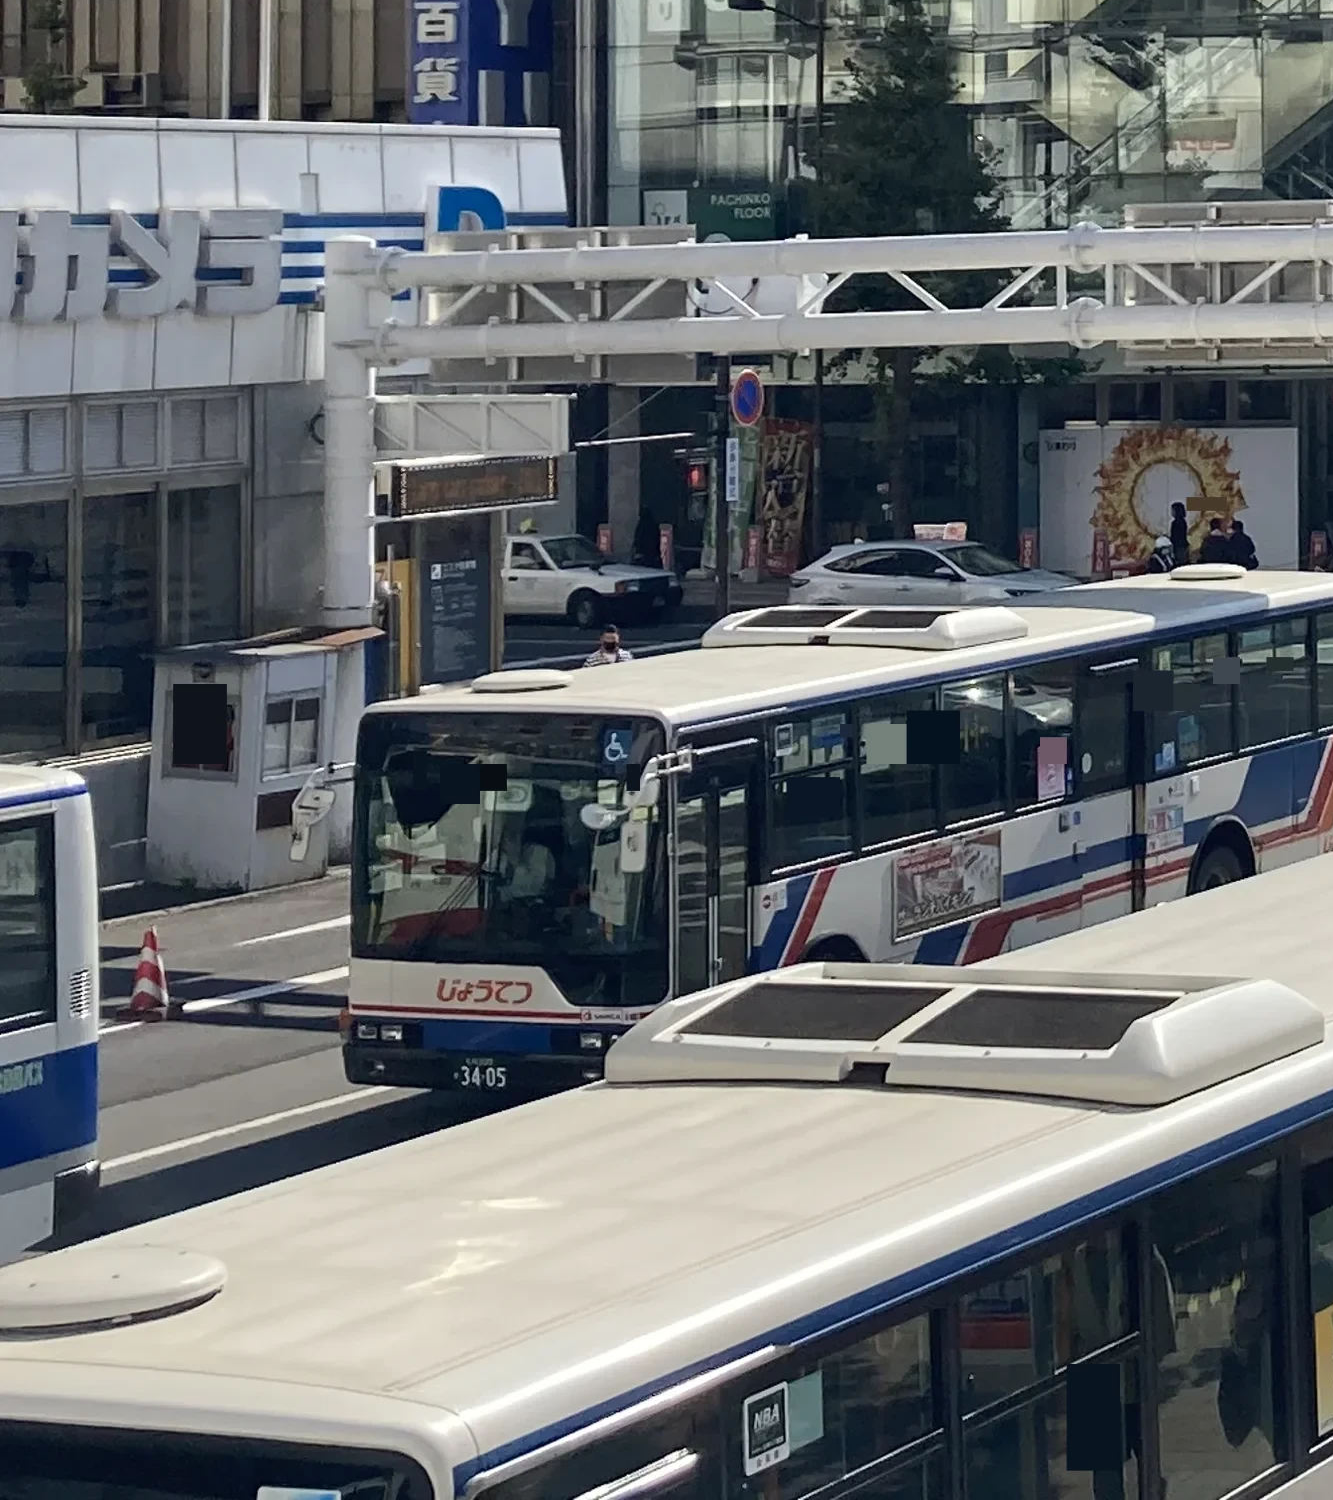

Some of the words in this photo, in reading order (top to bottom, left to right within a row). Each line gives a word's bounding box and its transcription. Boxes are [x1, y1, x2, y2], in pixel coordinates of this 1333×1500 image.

[709, 192, 771, 206] PACHINKO
[436, 977, 533, 1005] じょうてつ
